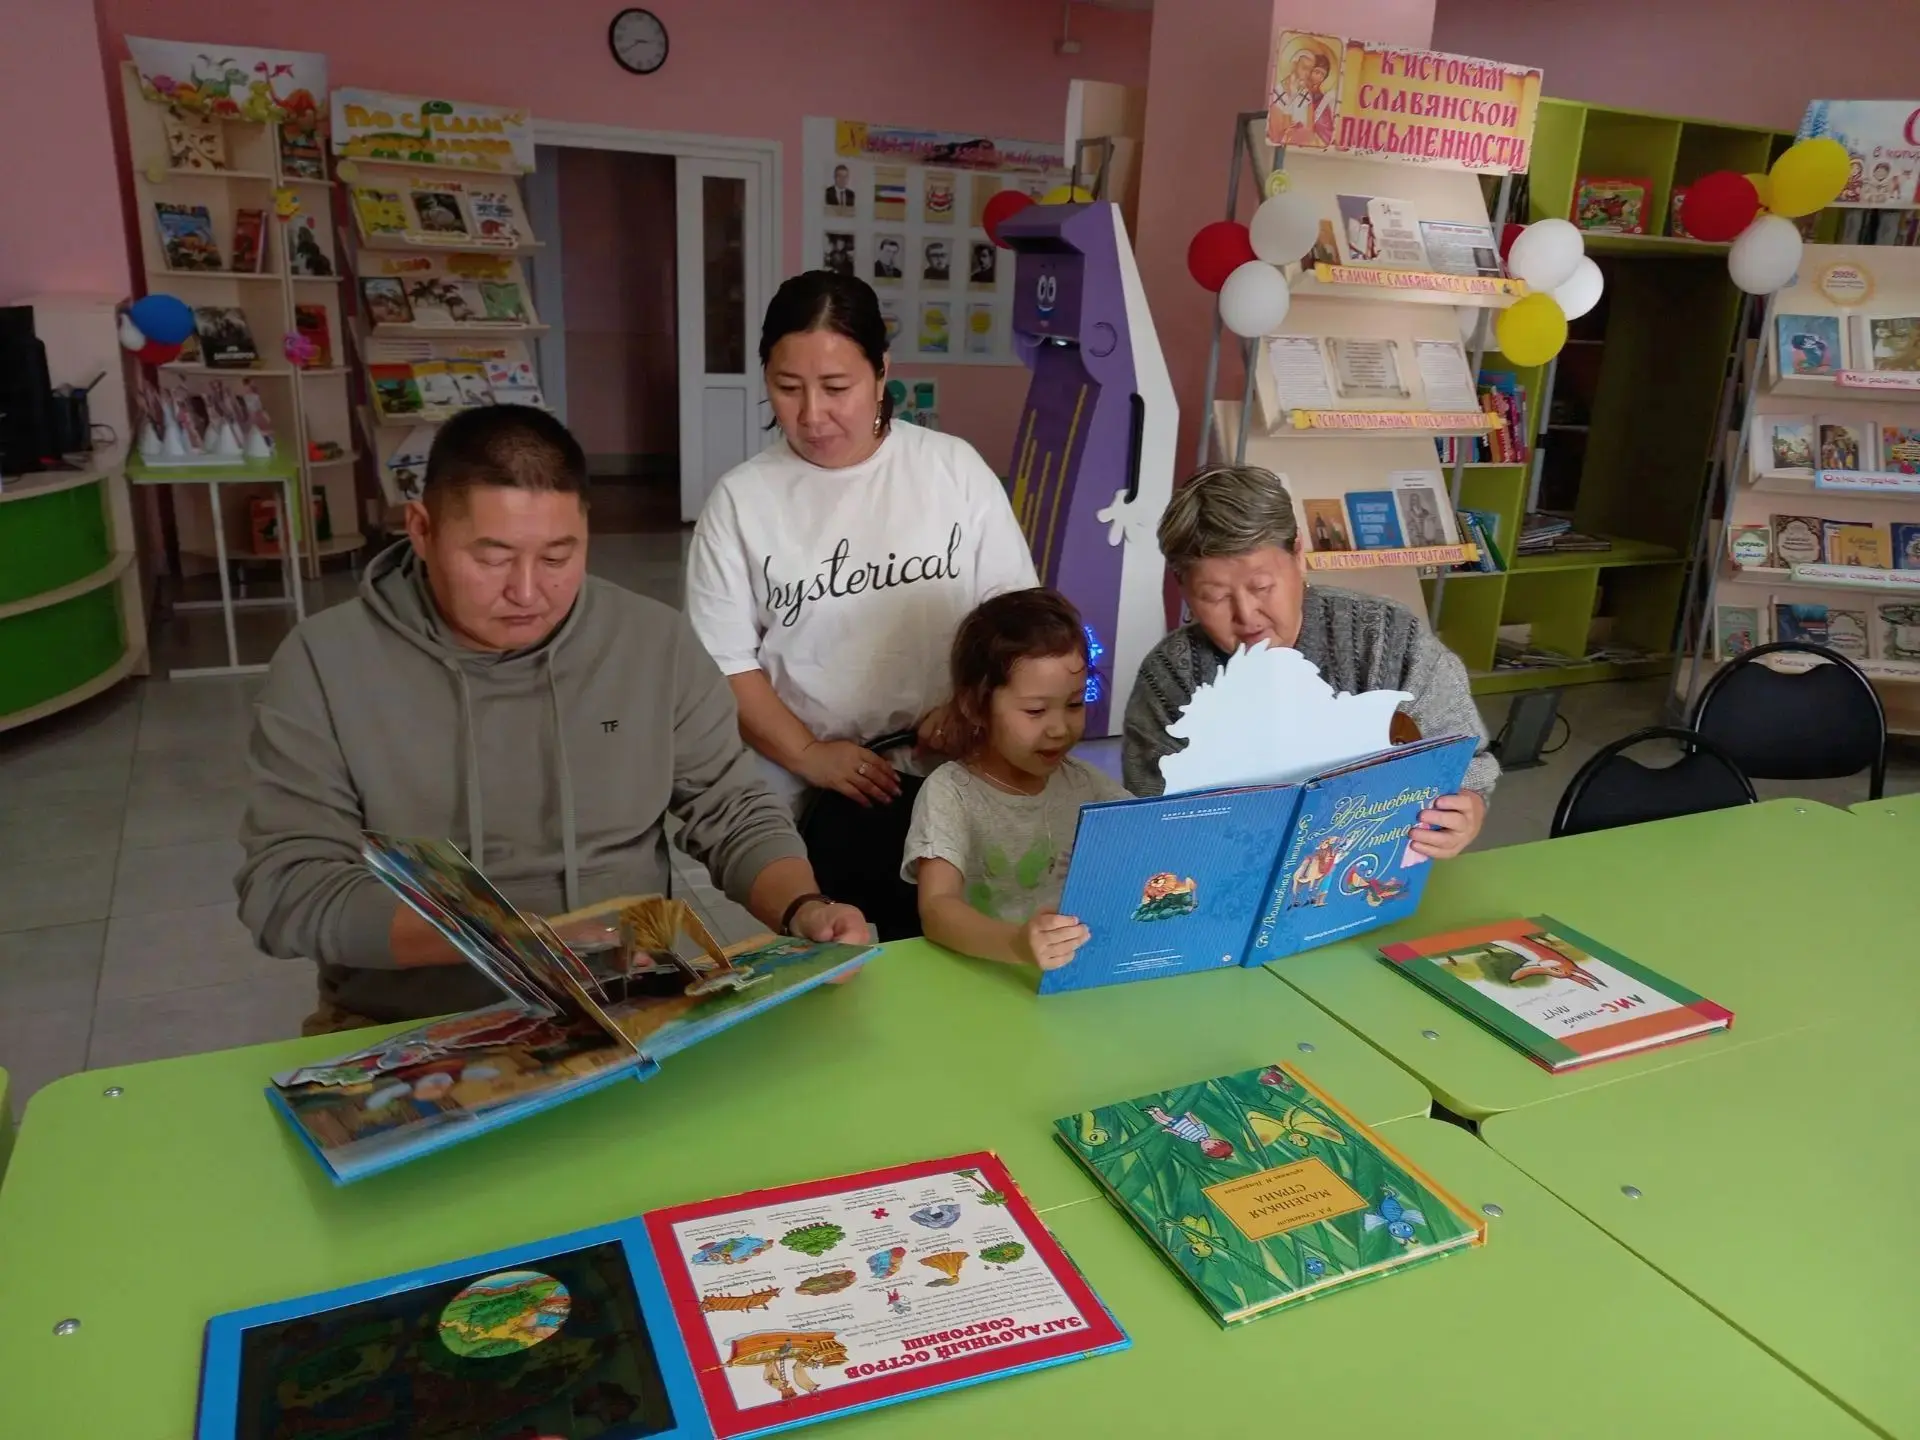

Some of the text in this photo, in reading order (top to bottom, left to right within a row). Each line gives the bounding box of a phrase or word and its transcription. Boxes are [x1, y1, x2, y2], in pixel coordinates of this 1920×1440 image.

[1381, 51, 1505, 93] К ИСТОКАМ
[1358, 84, 1519, 129] СЛАВЯНСКОЙ
[1338, 116, 1527, 169] ПИСЬМЕННОСТИ
[764, 522, 961, 627] hysterical
[1247, 1188, 1333, 1220] МАЛЕНЬКАЯ
[1252, 1183, 1307, 1204] СТРАНА
[844, 1316, 1082, 1380] ЗАГАДОЧНЫЙ ОСТРОВ
[900, 1317, 1016, 1352] СОКРОВИЩ
